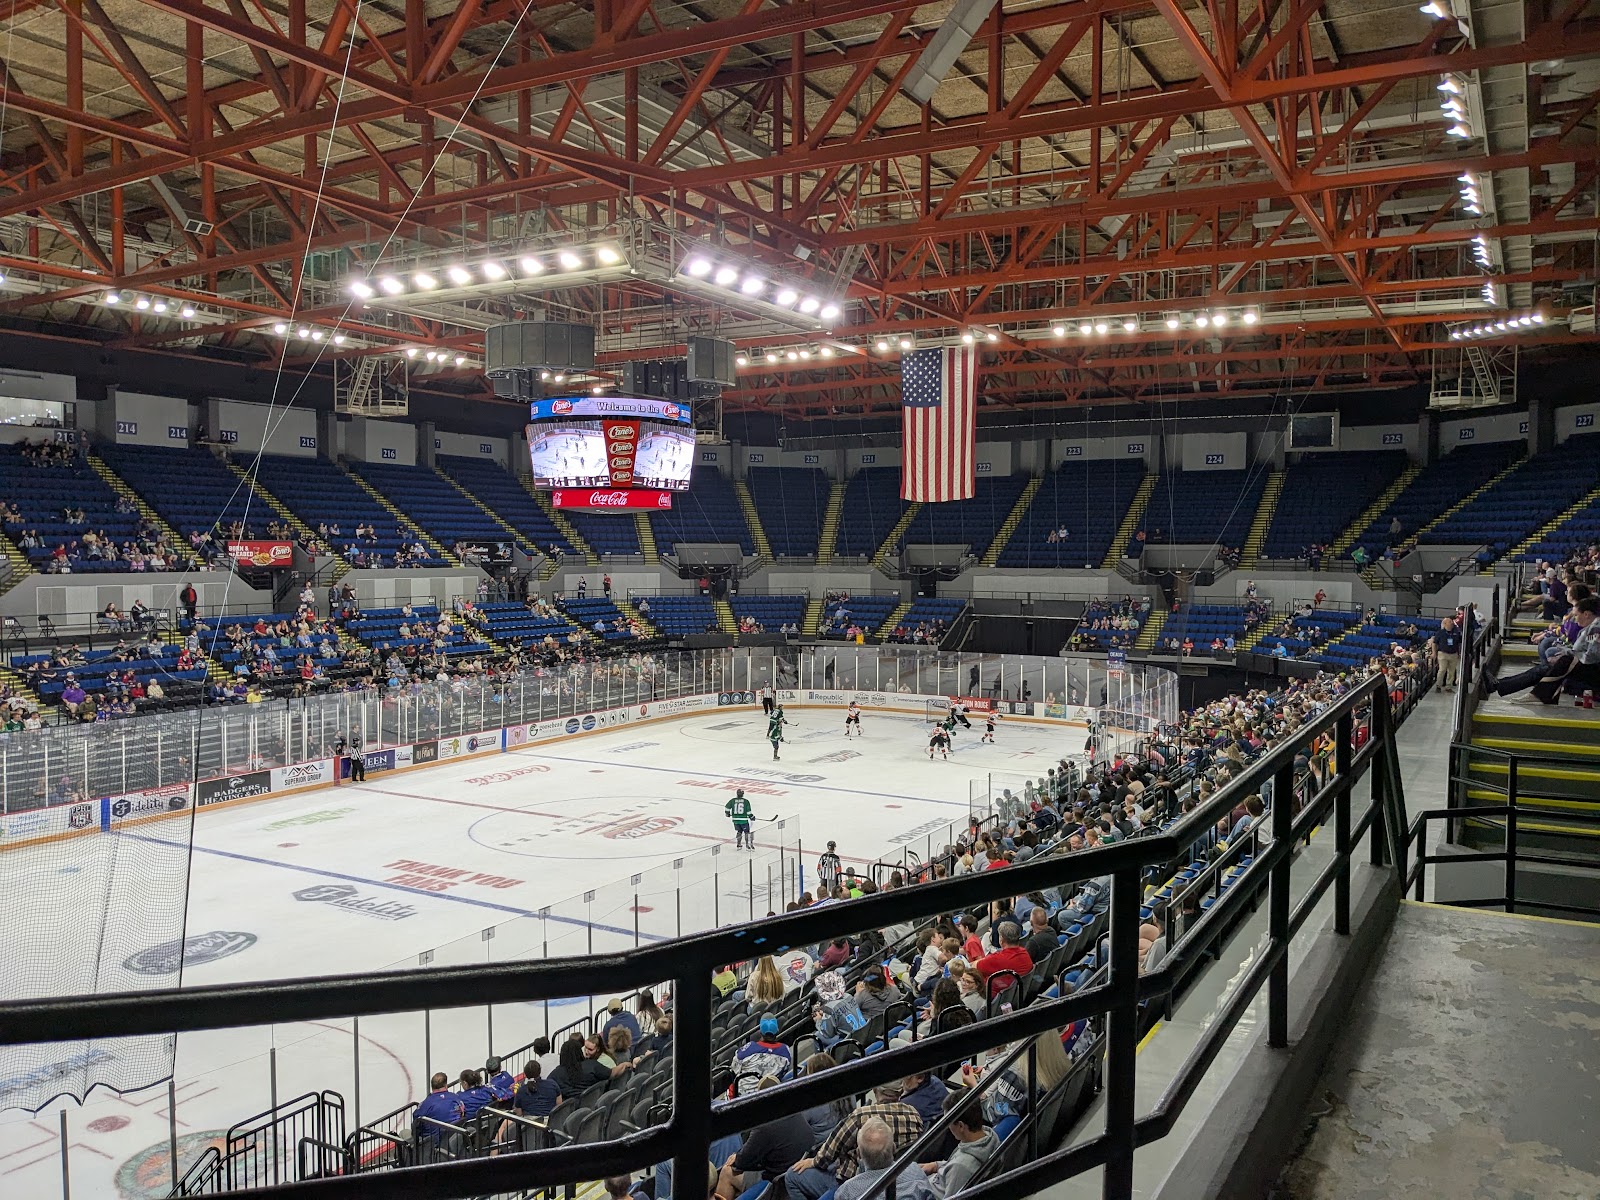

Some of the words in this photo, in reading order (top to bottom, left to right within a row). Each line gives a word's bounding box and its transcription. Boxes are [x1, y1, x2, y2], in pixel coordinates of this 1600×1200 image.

[597, 402, 635, 412] Welcome
[637, 403, 645, 412] to
[647, 403, 659, 413] the
[1577, 416, 1593, 426] 227
[117, 423, 136, 434] 214
[169, 428, 187, 438] 214
[607, 425, 635, 440] Cane's
[1460, 429, 1474, 438] 226
[56, 432, 75, 443] 213
[221, 431, 237, 441] 215
[1384, 435, 1401, 443] 225
[301, 438, 315, 447] 215
[383, 449, 395, 458] 216
[481, 444, 492, 453] 217
[608, 441, 634, 456] Cane's
[1067, 447, 1081, 455] 223
[1128, 445, 1143, 453] 223
[610, 456, 632, 469] Cane's
[703, 453, 716, 461] 219
[863, 455, 875, 463] 221
[1207, 455, 1223, 464] 224
[977, 463, 990, 471] 222
[611, 470, 632, 482] Cane's
[589, 491, 629, 506] Coca-Cola
[270, 546, 291, 558] Cane's
[815, 693, 843, 701] Republic
[974, 700, 989, 709] ROUGE
[364, 755, 387, 766] UEEN
[284, 776, 306, 786] SUPERIOR
[307, 773, 322, 783] GROUP
[204, 792, 244, 805] HEATING
[253, 786, 269, 795] AIR
[214, 784, 260, 798] BADGERS
[733, 803, 744, 814] 16
[382, 859, 474, 879] THANK
[461, 873, 526, 889] YOU
[384, 873, 459, 891] FANS
[291, 884, 419, 921] Fidelity
